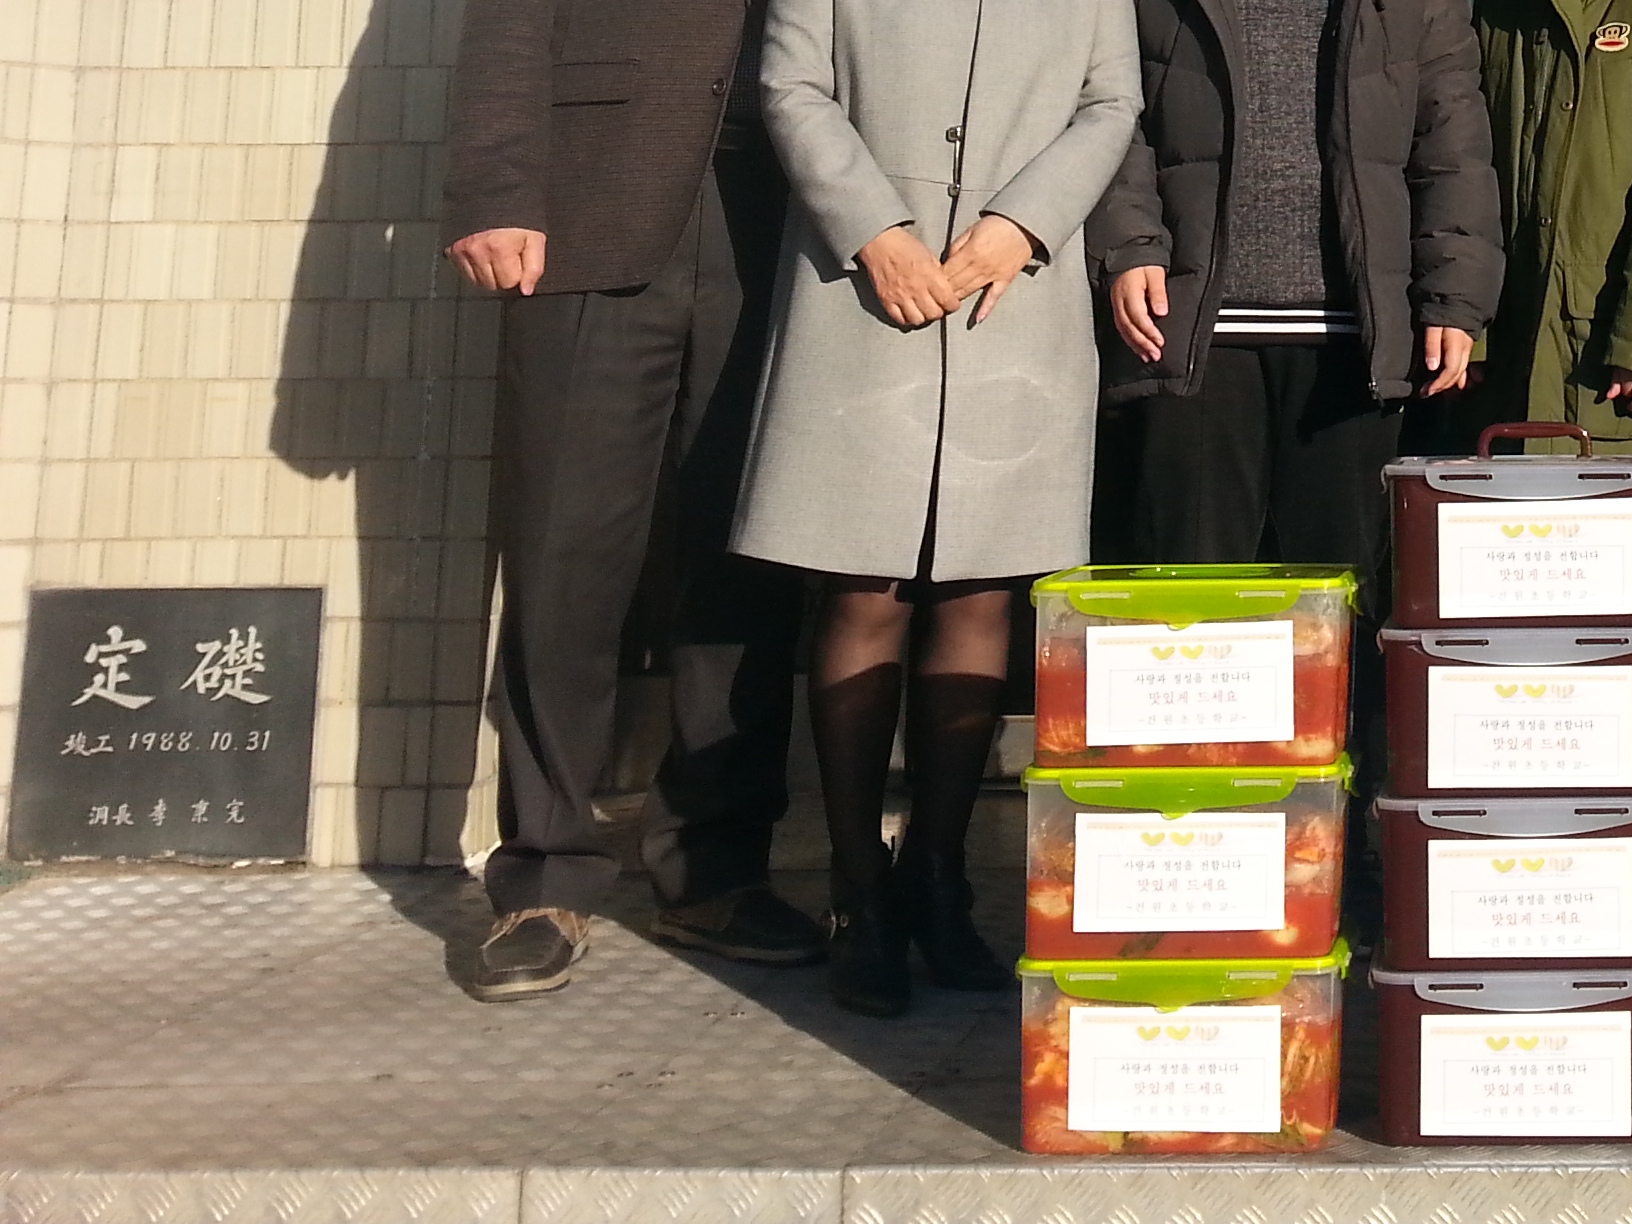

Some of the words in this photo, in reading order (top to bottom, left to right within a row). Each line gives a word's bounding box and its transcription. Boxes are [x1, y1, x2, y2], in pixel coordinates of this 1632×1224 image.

[1486, 552, 1516, 562] 사랑과
[1523, 551, 1551, 562] 정성을
[1559, 550, 1598, 561] 전합니다
[1499, 568, 1537, 582] 맛있게
[1546, 568, 1586, 581] 드세요
[70, 625, 273, 710] 定礎
[1136, 674, 1166, 685] 사랑과
[1174, 673, 1202, 684] 정성을
[1211, 672, 1250, 683] 전합니다
[1149, 691, 1188, 705] 맛있게
[1197, 690, 1238, 704] 드세요
[1480, 720, 1510, 730] 사랑과
[1517, 720, 1545, 730] 정성을
[1554, 719, 1593, 730] 전합니다
[246, 730, 271, 752] 31
[1493, 737, 1532, 750] 맛있게
[1541, 737, 1581, 750] 드세요
[1125, 861, 1155, 871] 사랑과
[1163, 860, 1192, 871] 정성을
[1200, 860, 1241, 871] 전합니다
[1137, 878, 1177, 892] 맛있게
[1186, 878, 1228, 891] 드세요
[1478, 895, 1508, 906] 사랑과
[1515, 894, 1544, 905] 정성을
[1553, 892, 1593, 904] 전합니다
[1491, 912, 1531, 926] 맛있게
[1540, 911, 1581, 925] 드세요
[1121, 1064, 1151, 1074] 사랑과
[1159, 1064, 1188, 1074] 정성을
[1197, 1063, 1238, 1075] 전합니다
[1470, 1065, 1500, 1076] 사랑과
[1508, 1064, 1537, 1075] 정성을
[1545, 1063, 1586, 1075] 전합니다
[1134, 1082, 1174, 1095] 맛있게
[1183, 1082, 1225, 1095] 드세요
[1483, 1083, 1523, 1097] 맛있게
[1532, 1082, 1574, 1096] 드세요
